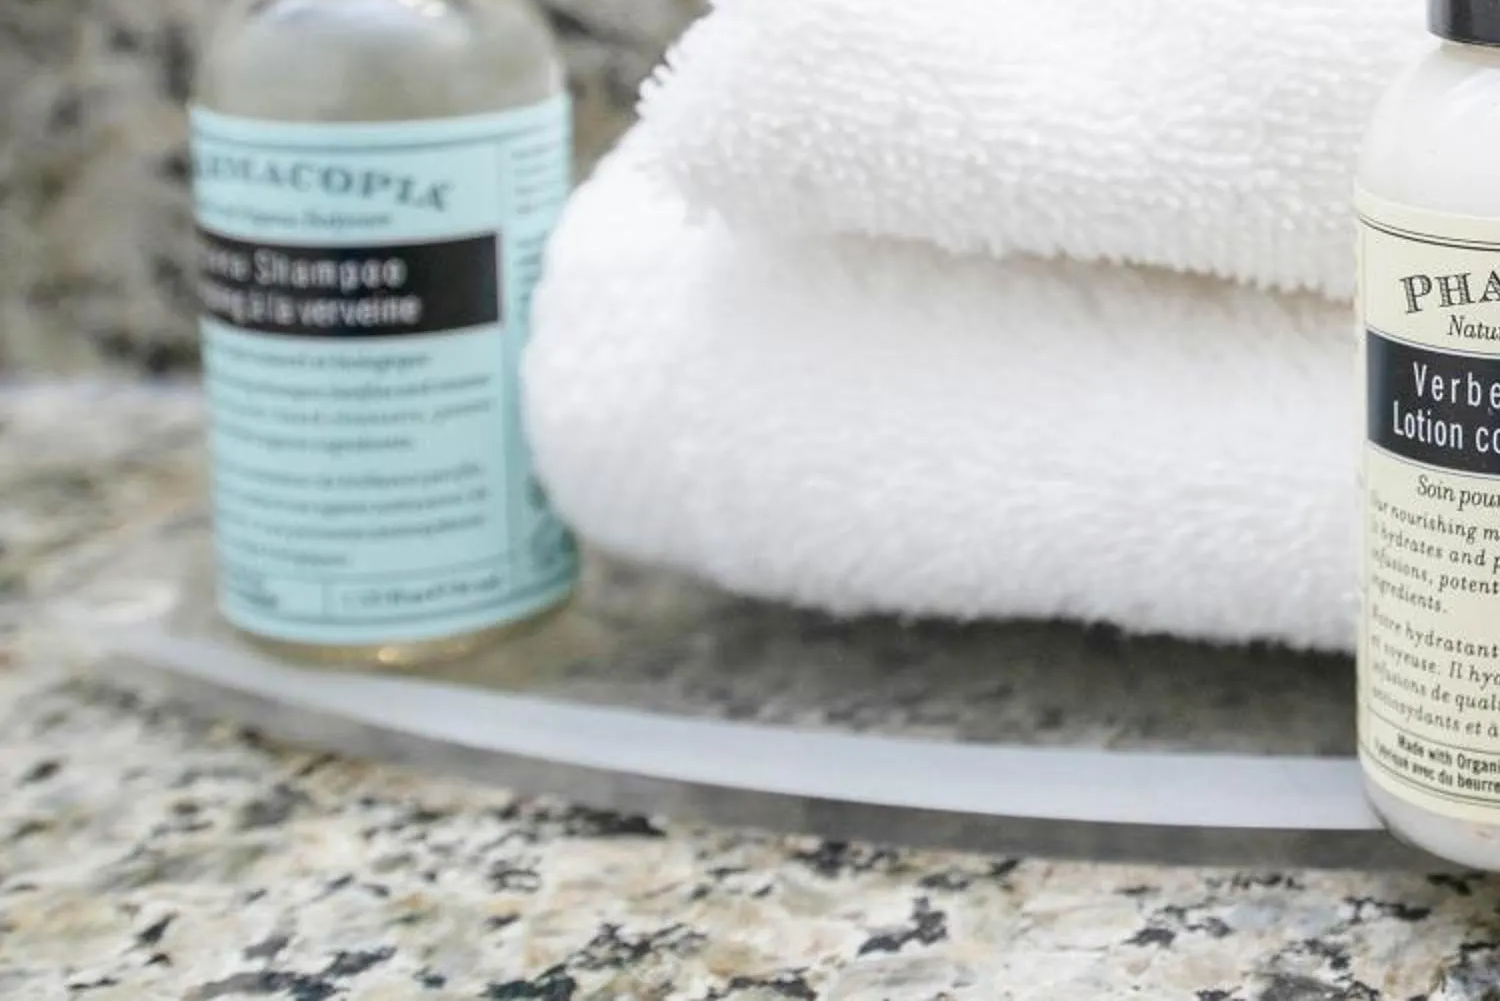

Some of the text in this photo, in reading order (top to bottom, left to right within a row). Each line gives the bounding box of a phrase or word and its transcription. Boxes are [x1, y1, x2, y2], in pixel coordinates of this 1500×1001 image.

[253, 247, 408, 295] Shampoo
[1391, 400, 1464, 450] Lotion
[1416, 474, 1455, 502] Soin
[1391, 506, 1478, 544] nourishing
[1449, 548, 1488, 568] and
[1438, 571, 1500, 595] potent
[1404, 621, 1500, 660] hydratant
[1449, 660, 1464, 680] Il
[1430, 683, 1451, 704] de
[1464, 720, 1482, 737] et
[1486, 721, 1499, 738] à
[1428, 748, 1453, 766] with
[1437, 767, 1454, 787] du
